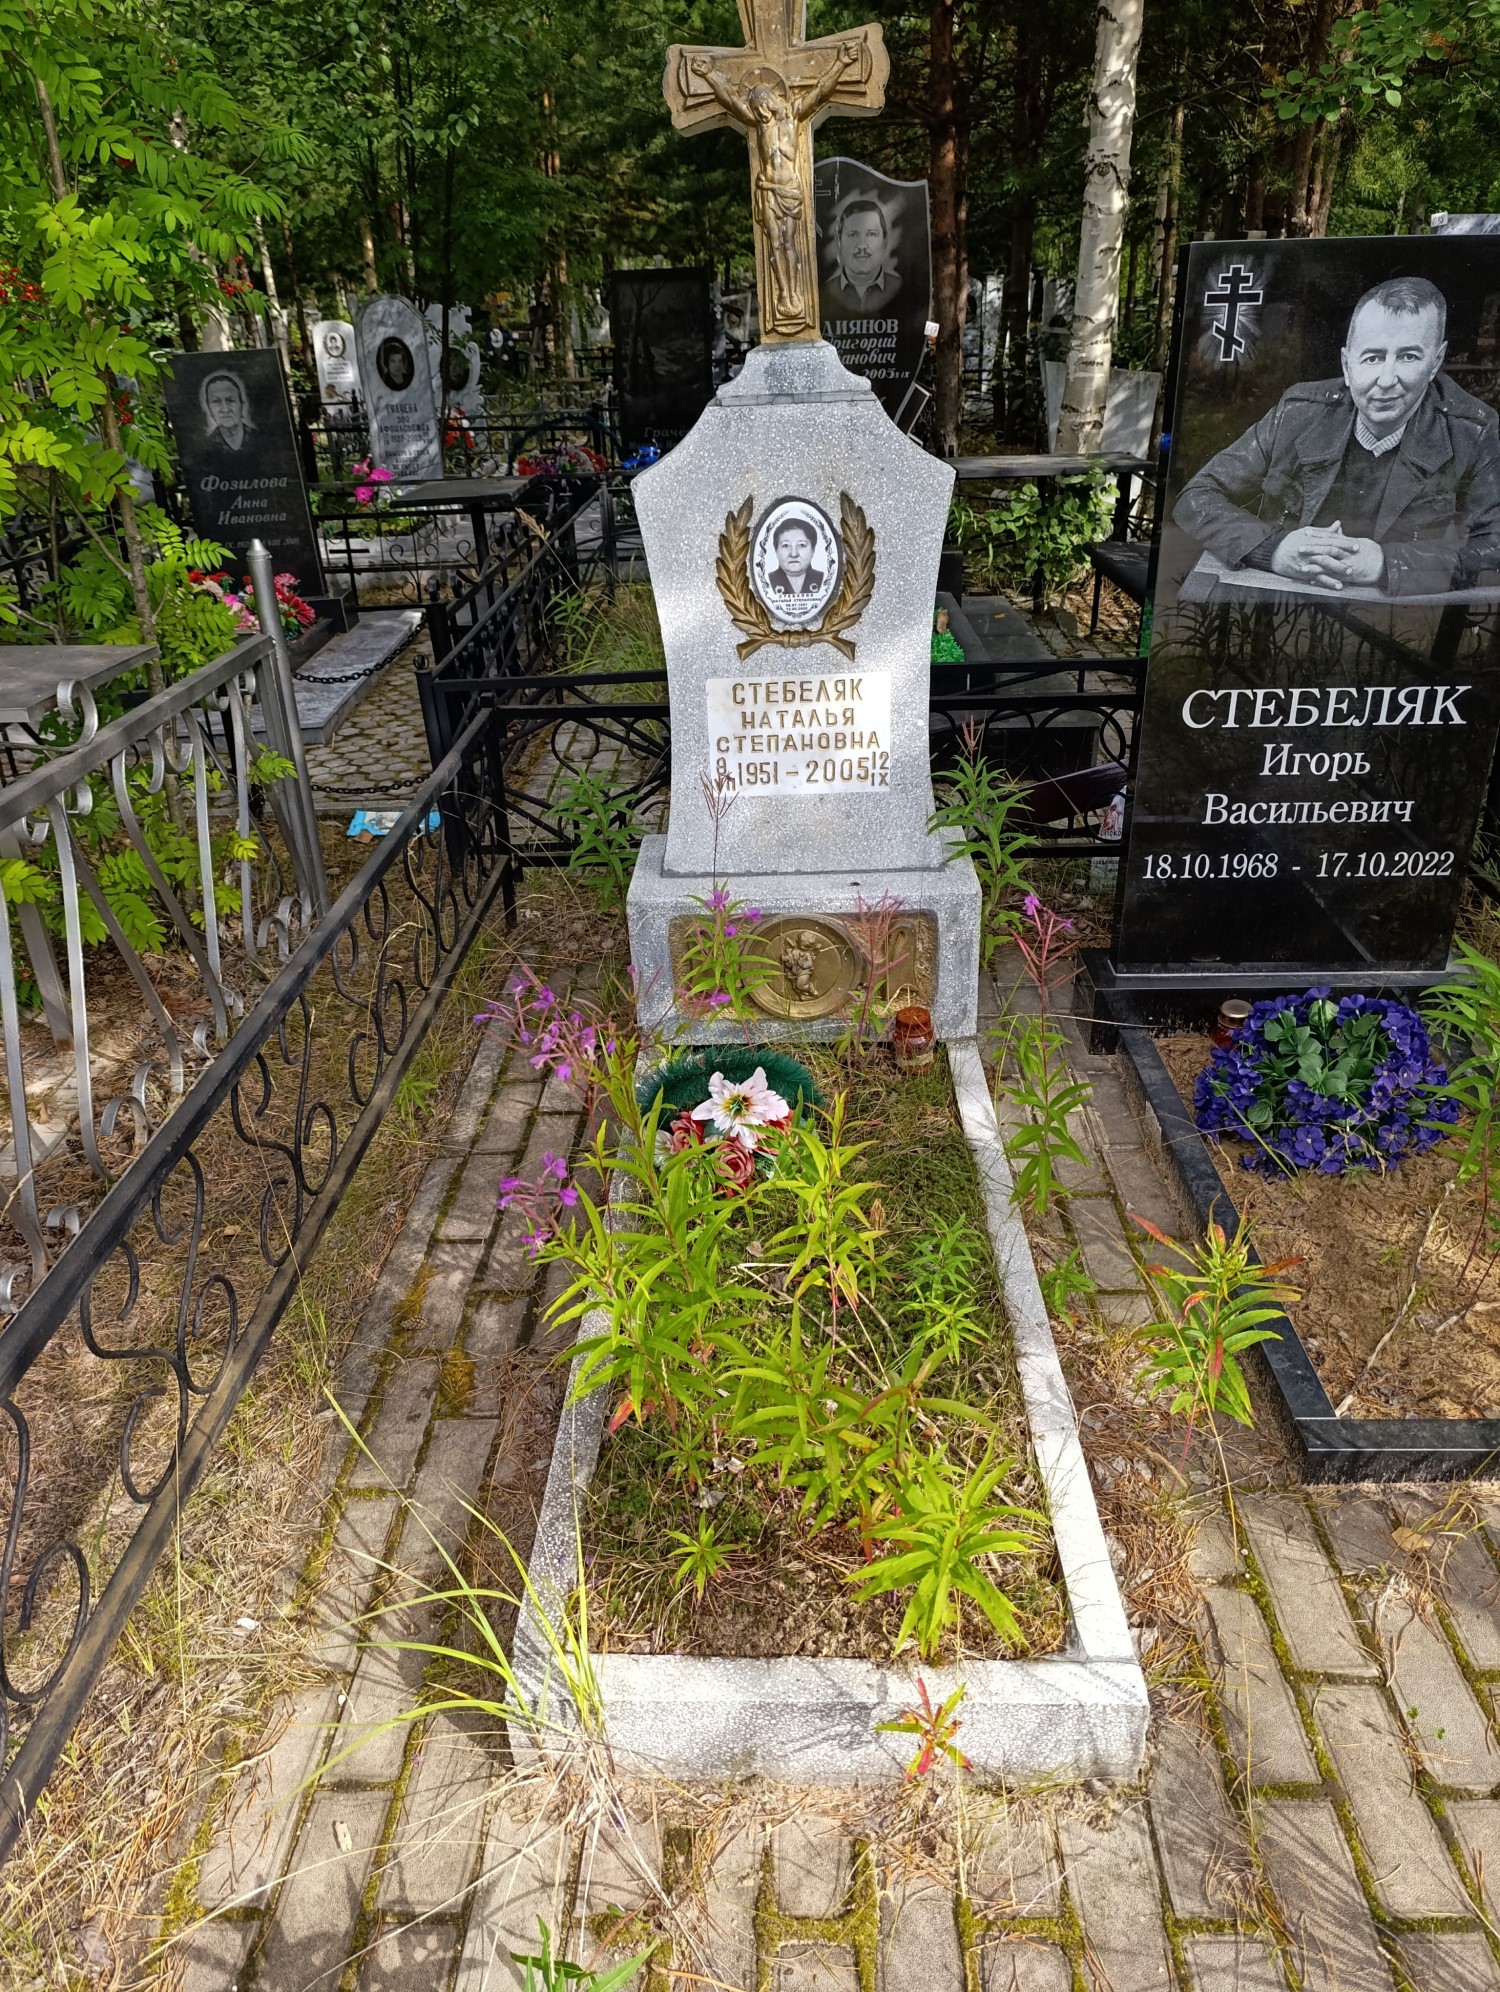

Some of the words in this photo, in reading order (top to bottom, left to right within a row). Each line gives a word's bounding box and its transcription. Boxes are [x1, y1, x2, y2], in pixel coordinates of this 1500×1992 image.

[200, 475, 288, 492] Фозилова
[230, 495, 268, 510] Анна
[217, 510, 287, 525] Ивановна
[732, 679, 863, 706] СТЕБЕЛЯК
[741, 708, 855, 730] НАТАЛЬЯ
[1181, 685, 1472, 729] СТЕБЕЛЯК
[716, 731, 881, 754] СТЕПАНОВНА
[738, 761, 779, 787] 1951
[806, 757, 870, 784] 2005
[1259, 743, 1371, 782] Игорь
[1201, 793, 1415, 825] Васильевич
[1142, 853, 1279, 879] 18.10.1968
[1316, 852, 1455, 878] 17.10.2022
